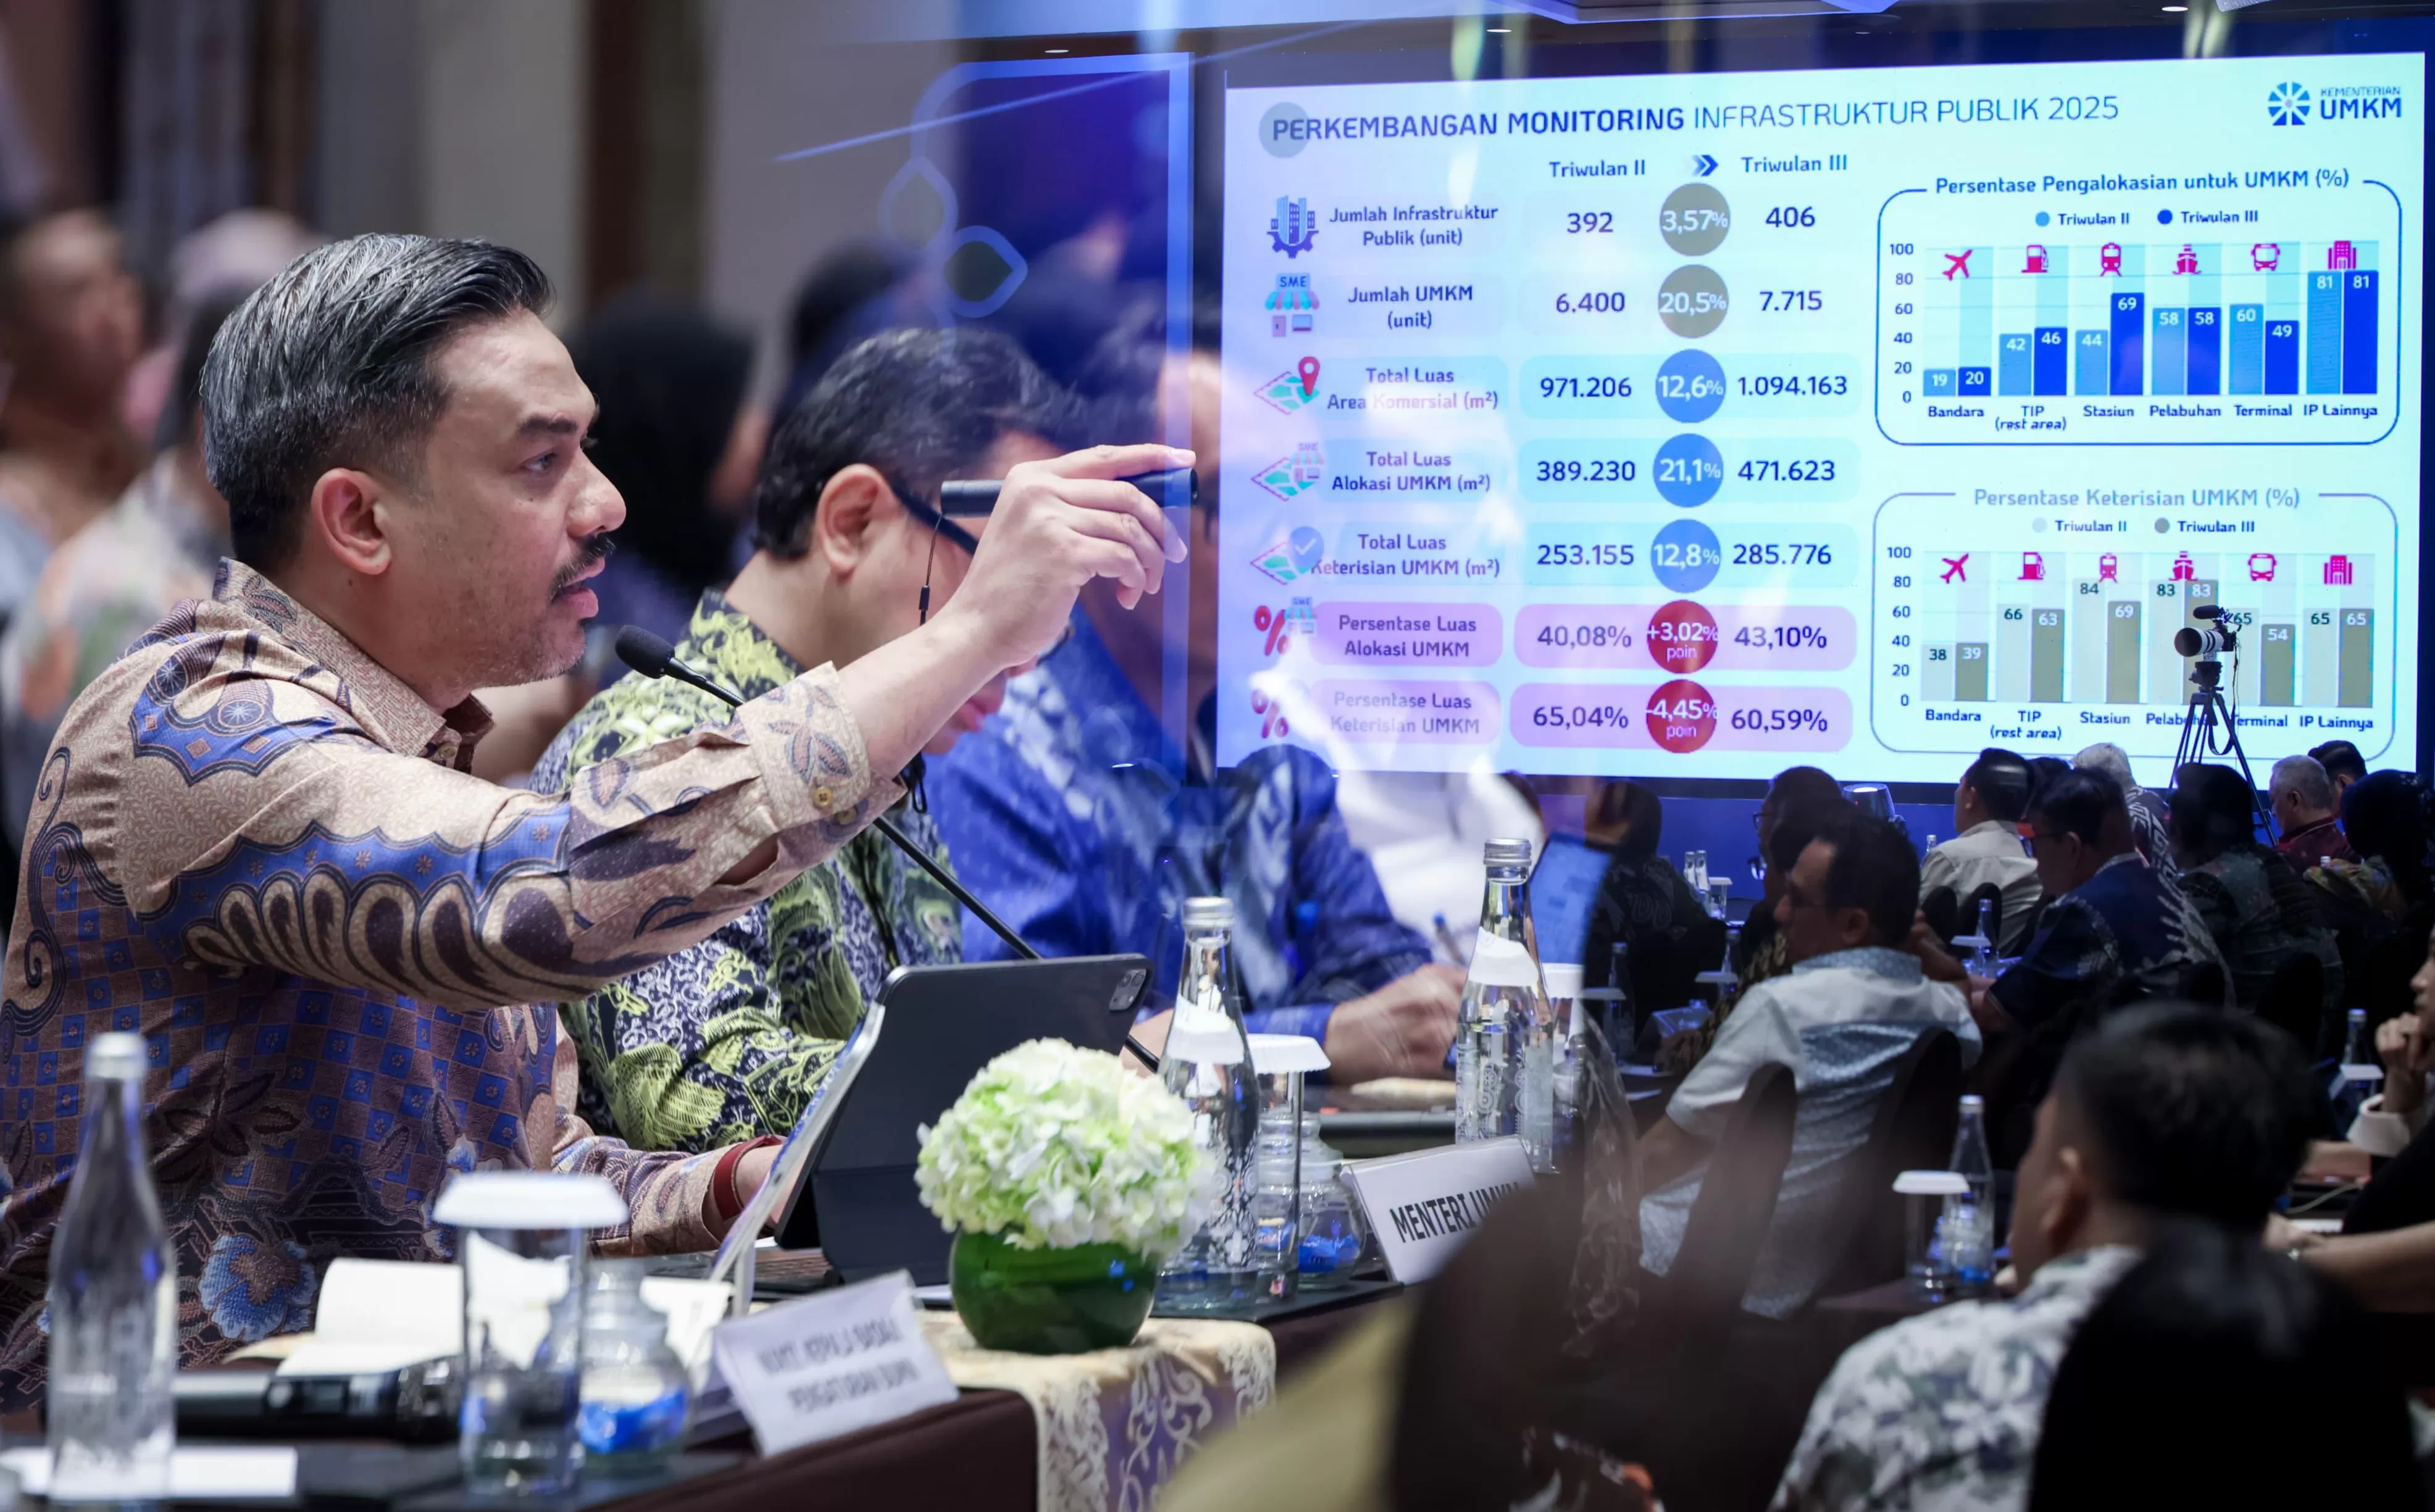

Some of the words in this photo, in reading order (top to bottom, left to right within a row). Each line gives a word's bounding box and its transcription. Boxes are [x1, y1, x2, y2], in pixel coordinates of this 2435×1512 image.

[2321, 86, 2401, 97] KEMENTERIAN
[2320, 98, 2402, 120] UMKM
[1272, 112, 1498, 141] PERKEMBANGAN
[1508, 107, 1684, 135] MONITORING
[1694, 101, 1928, 128] INFRASTRUKTUR
[1937, 96, 2039, 122] PUBLIK
[2049, 95, 2119, 119] 2025
[1549, 161, 1629, 178] Triwulan
[1634, 160, 1646, 177] II
[1741, 156, 1823, 174] Triwulan
[1829, 156, 1847, 172] III
[1936, 176, 2038, 194] Persentase
[2043, 173, 2178, 194] Pengalokasian
[2184, 173, 2239, 189] untuk
[2245, 171, 2308, 188] UMKM
[2316, 169, 2349, 188] (%)
[1329, 206, 1387, 225] Jumlah
[1393, 205, 1498, 223] Infrastruktur
[1661, 209, 1729, 233] 3,57%
[1765, 206, 1816, 229] 406
[2058, 213, 2116, 225] Triwulan
[2121, 212, 2129, 224] II
[2181, 211, 2240, 224] Triwulan
[2245, 211, 2258, 222] III
[1566, 212, 1614, 234] 392
[1363, 230, 1414, 247] Publik
[1419, 228, 1463, 247] (unit)
[1889, 243, 1914, 255] 100
[1279, 275, 1308, 289] SME
[1895, 273, 1913, 285] 80
[2317, 276, 2333, 288] 81
[2352, 276, 2370, 288] 81
[1348, 286, 1410, 305] Jumlah
[1414, 285, 1472, 303] UMKM
[1759, 290, 1823, 312] 7.715
[1555, 292, 1626, 314] 6.400
[1658, 292, 1727, 316] 20,5%
[1895, 303, 1913, 314] 60
[2118, 297, 2137, 309] 69
[1387, 311, 1432, 331] (unit)
[2160, 312, 2179, 325] 58
[2195, 312, 2214, 325] 58
[2237, 309, 2256, 322] 60
[1894, 332, 1913, 343] 40
[2041, 332, 2061, 345] 46
[2273, 325, 2292, 338] 49
[2007, 337, 2026, 351] 42
[2082, 335, 2102, 347] 44
[1894, 361, 1912, 373] 20
[1366, 368, 1408, 385] Total
[1413, 367, 1454, 384] Luas
[1931, 373, 1947, 386] 19
[1965, 372, 1984, 385] 20
[1540, 377, 1632, 400] 971.206
[1657, 375, 1724, 400] 12,6%
[1737, 375, 1848, 397] 1.094.163
[1327, 393, 1367, 411] Area
[1372, 393, 1458, 411] Komersial
[1902, 391, 1912, 403] 0
[1928, 406, 1984, 418] Bandara
[2021, 406, 2045, 417] TIP
[2083, 404, 2134, 417] Stasiun
[2150, 404, 2221, 417] Pelabuhan
[2234, 404, 2292, 416] Terminal
[2304, 404, 2319, 416] IP
[2323, 404, 2378, 420] Lainnya
[1995, 417, 2026, 432] (rest
[2031, 417, 2066, 432] area)
[1367, 451, 1408, 467] Total
[1413, 451, 1451, 467] Luas
[1536, 461, 1635, 482] 389.230
[1658, 461, 1721, 482] 21,1%
[1737, 461, 1836, 482] 471.623
[1332, 475, 1392, 493] Alokasi
[1397, 475, 1453, 493] UMKM
[1974, 489, 2079, 506] Persentase
[2086, 489, 2185, 506] Keterisian
[2192, 489, 2257, 507] UMKM
[2266, 489, 2300, 508] (%)
[2055, 520, 2115, 533] Triwulan
[2118, 520, 2127, 532] II
[2178, 520, 2238, 533] Triwulan
[2242, 520, 2255, 533] III
[1358, 535, 1403, 551] Total
[1407, 534, 1447, 551] Luas
[1536, 545, 1634, 566] 253.155
[1653, 543, 1719, 568] 12,8%
[1732, 544, 1832, 567] 285.776
[1887, 547, 1912, 559] 100
[1311, 559, 1397, 577] Keterisian
[1401, 559, 1460, 577] UMKM
[1894, 576, 1911, 588] 80
[2080, 582, 2099, 596] 84
[2157, 584, 2176, 597] 83
[2192, 583, 2211, 596] 83
[1893, 606, 1911, 617] 60
[2004, 608, 2023, 620] 66
[2039, 612, 2058, 625] 63
[2115, 605, 2134, 618] 69
[2233, 612, 2252, 625] 65
[2311, 612, 2330, 625] 65
[2347, 612, 2366, 625] 65
[1339, 614, 1432, 633] Persentase
[1439, 616, 1477, 633] Luas
[1537, 626, 1632, 651] 40,08%
[1647, 622, 1718, 645] +3,02%
[1734, 625, 1827, 651] 43,10%
[1892, 635, 1910, 646] 40
[2268, 628, 2288, 641] 54
[1345, 640, 1408, 659] Alokasi
[1413, 640, 1470, 659] UMKM
[1666, 645, 1697, 662] poin
[1929, 648, 1947, 661] 38
[1963, 646, 1981, 659] 39
[1892, 664, 1910, 676] 20
[1334, 691, 1425, 710] Persentase
[1431, 693, 1471, 711] Luas
[1900, 695, 1909, 706] 0
[1532, 705, 1629, 731] 65,04%
[1731, 709, 1827, 733] 60,59%
[1926, 709, 1981, 722] Bandara
[2018, 710, 2041, 722] TIP
[2080, 712, 2131, 724] Stasiun
[1330, 717, 1414, 735] Keterisian
[1421, 718, 1479, 736] UMKM
[2300, 716, 2316, 728] IP
[2319, 716, 2373, 730] Lainnya
[1990, 725, 2021, 740] (rest
[2026, 726, 2061, 740] area)
[1390, 1193, 1477, 1243] MENTERI
